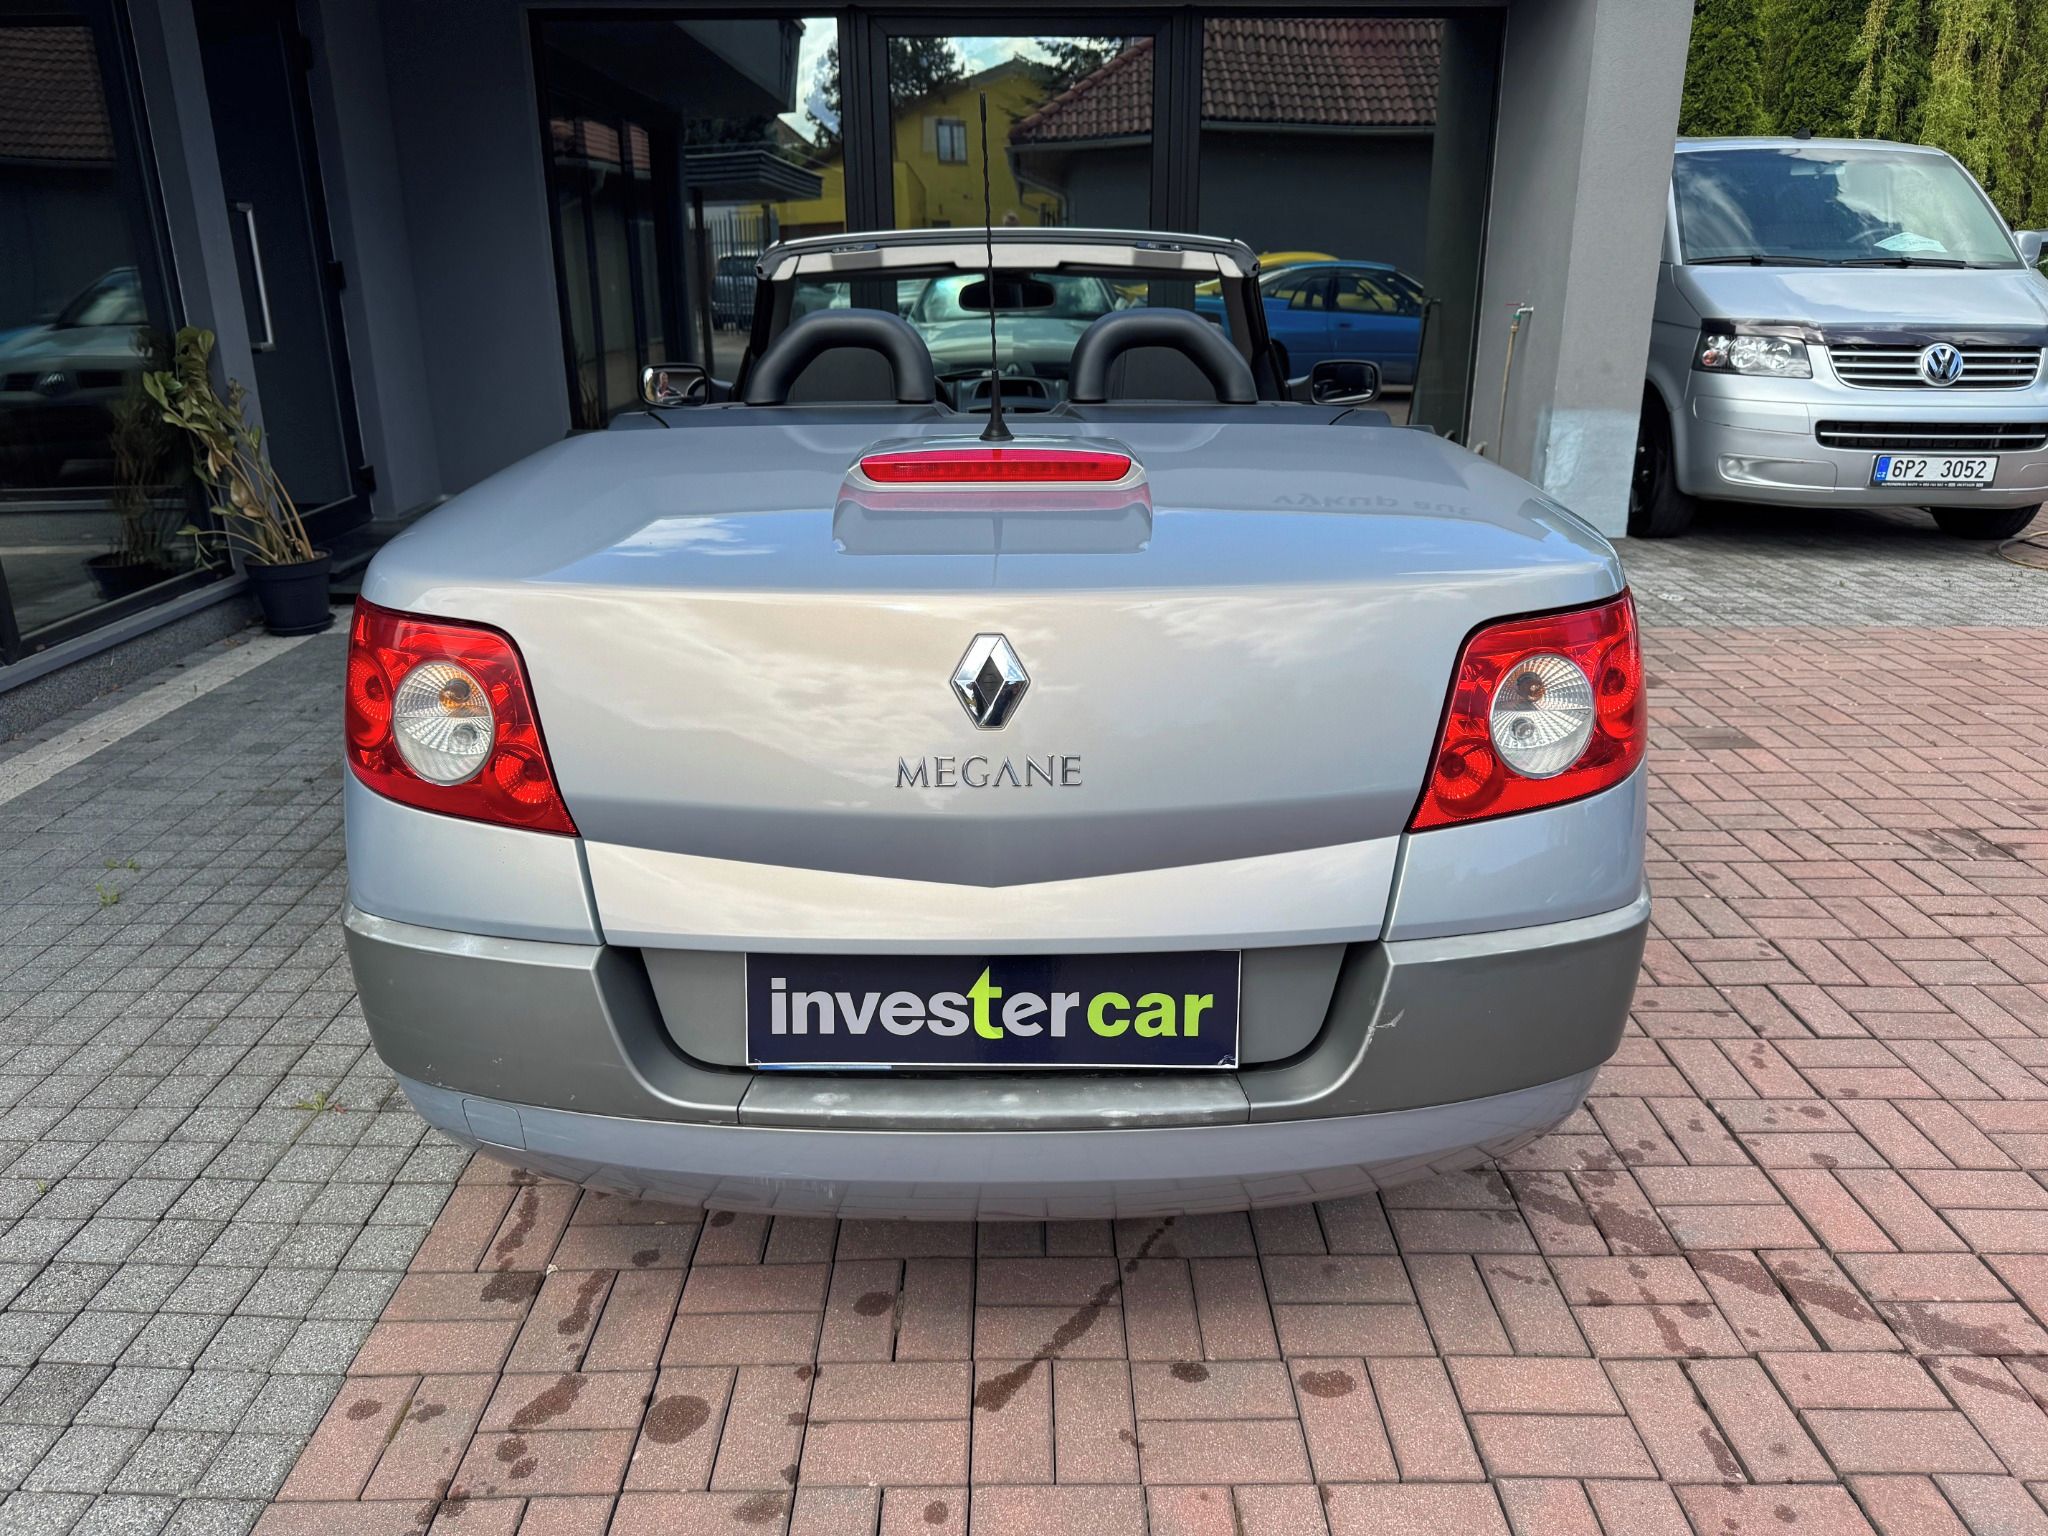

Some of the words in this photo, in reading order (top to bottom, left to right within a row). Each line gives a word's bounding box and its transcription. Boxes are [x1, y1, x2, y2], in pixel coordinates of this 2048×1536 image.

[1892, 460, 1927, 478] 6P2
[1940, 460, 1986, 478] 3052
[895, 754, 1082, 787] MEGANE
